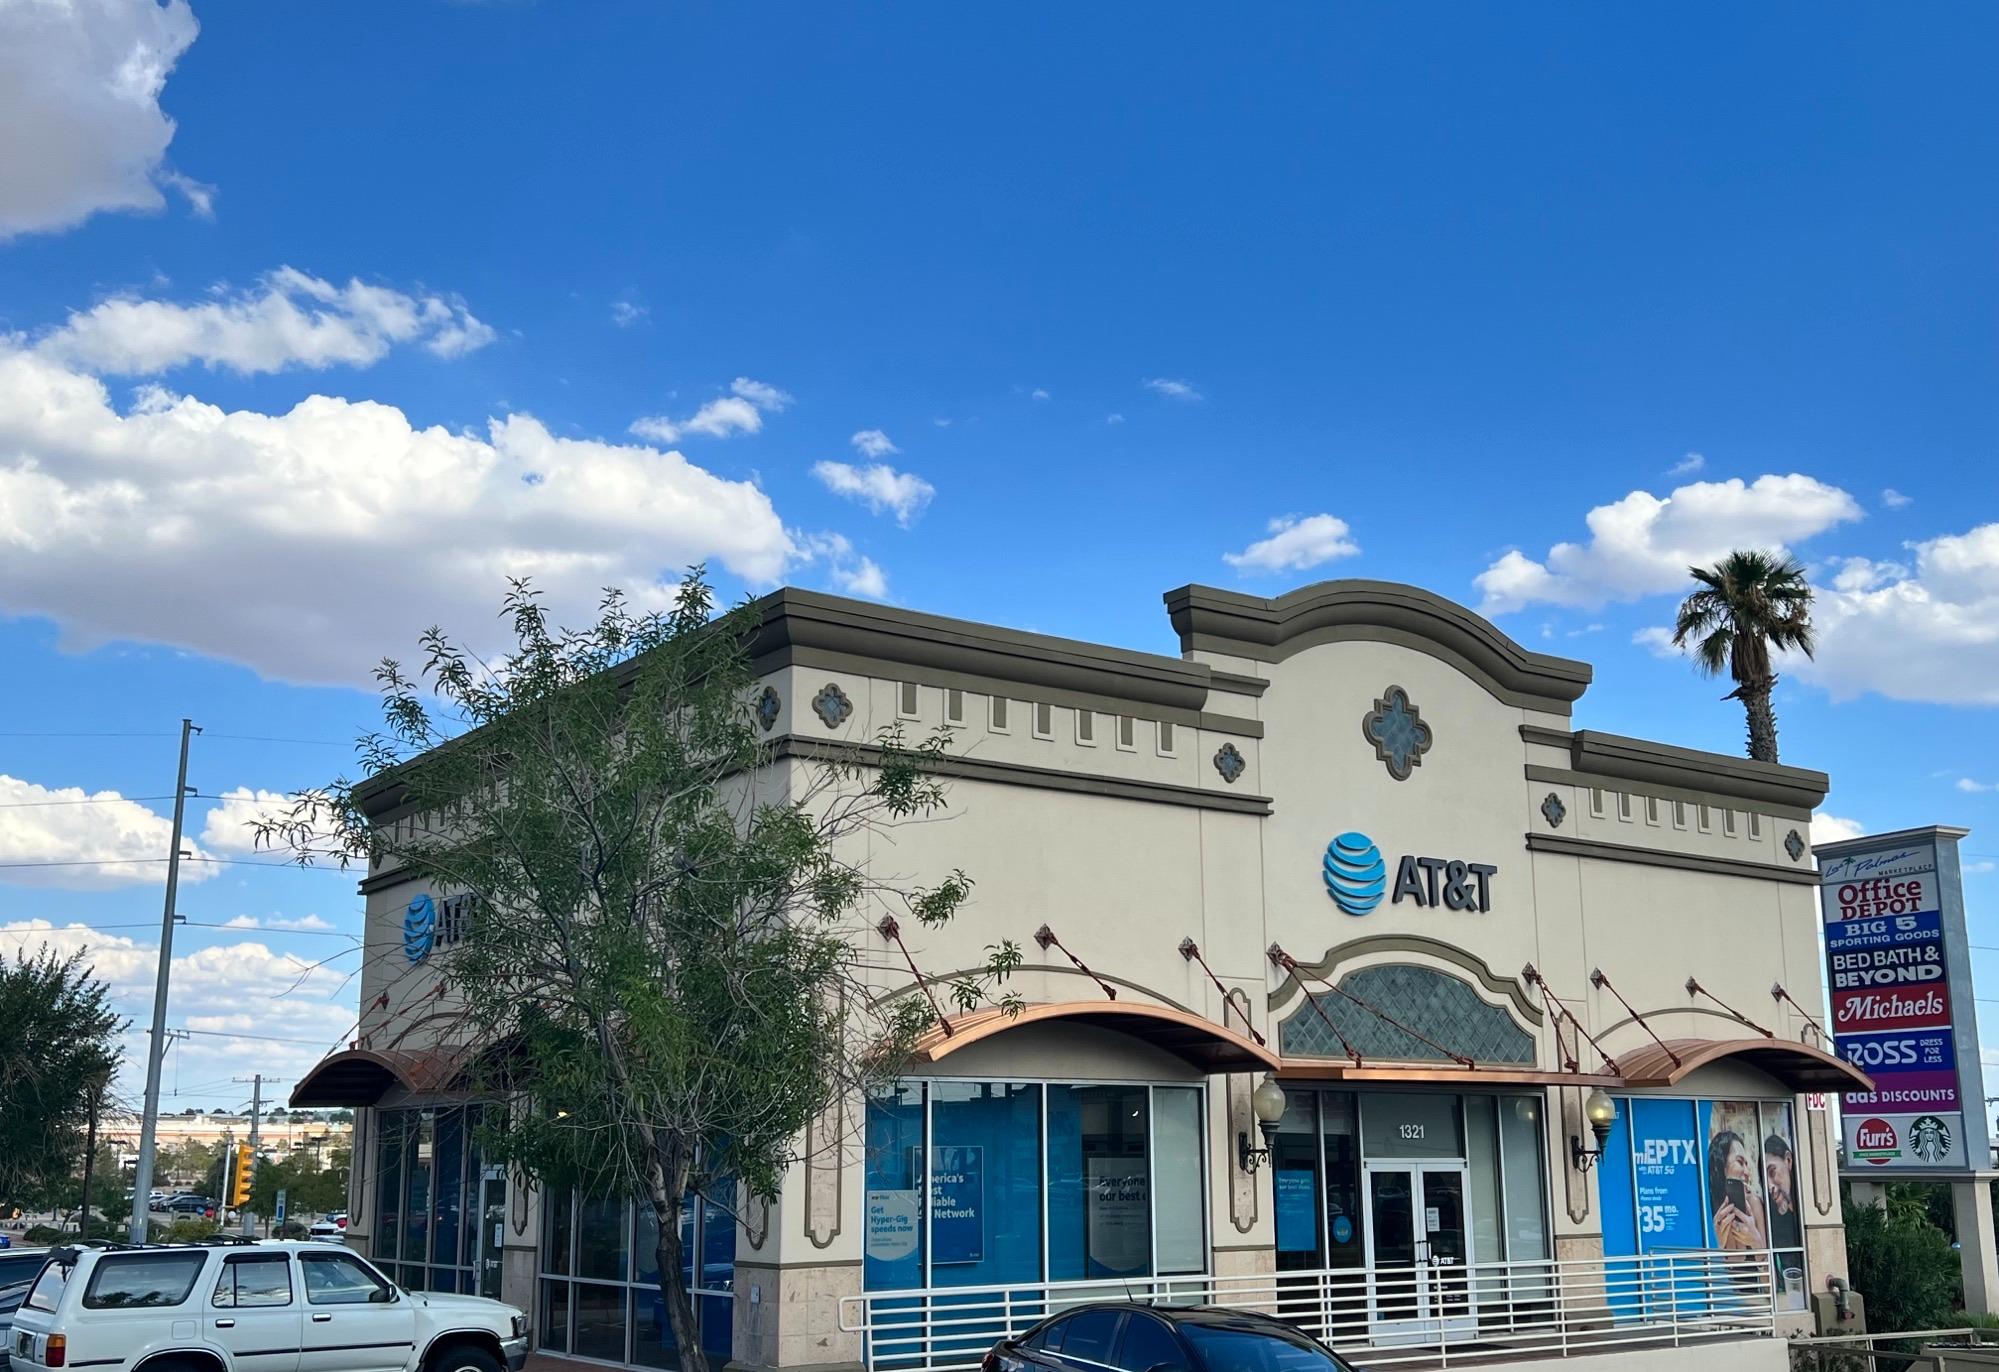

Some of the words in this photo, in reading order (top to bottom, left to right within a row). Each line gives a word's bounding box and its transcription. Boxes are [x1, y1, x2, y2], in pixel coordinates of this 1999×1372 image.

[1878, 864, 1933, 876] MARKETPLACE
[1392, 855, 1497, 913] AT&T
[1838, 878, 1922, 905] Office
[1840, 897, 1922, 921] DEPOT
[1845, 920, 1887, 937] BIG
[1895, 916, 1917, 931] 5
[1830, 935, 1891, 948] SPORTING
[1895, 929, 1940, 941] GOODS
[1833, 952, 1871, 971] BED
[1873, 947, 1921, 967] BATH
[1924, 945, 1940, 961] &
[1835, 964, 1943, 988] BEYOND
[1838, 991, 1943, 1022] Michaels
[1919, 1038, 1943, 1047] DRESS
[1925, 1047, 1940, 1055] FOR
[1846, 1040, 1918, 1067] ROSS
[1923, 1054, 1943, 1063] LESS
[1881, 1088, 1955, 1102] DISCOUNTS
[1399, 1124, 1425, 1139] 1321
[1860, 1127, 1894, 1147] Furr's
[934, 1207, 975, 1219] Network
